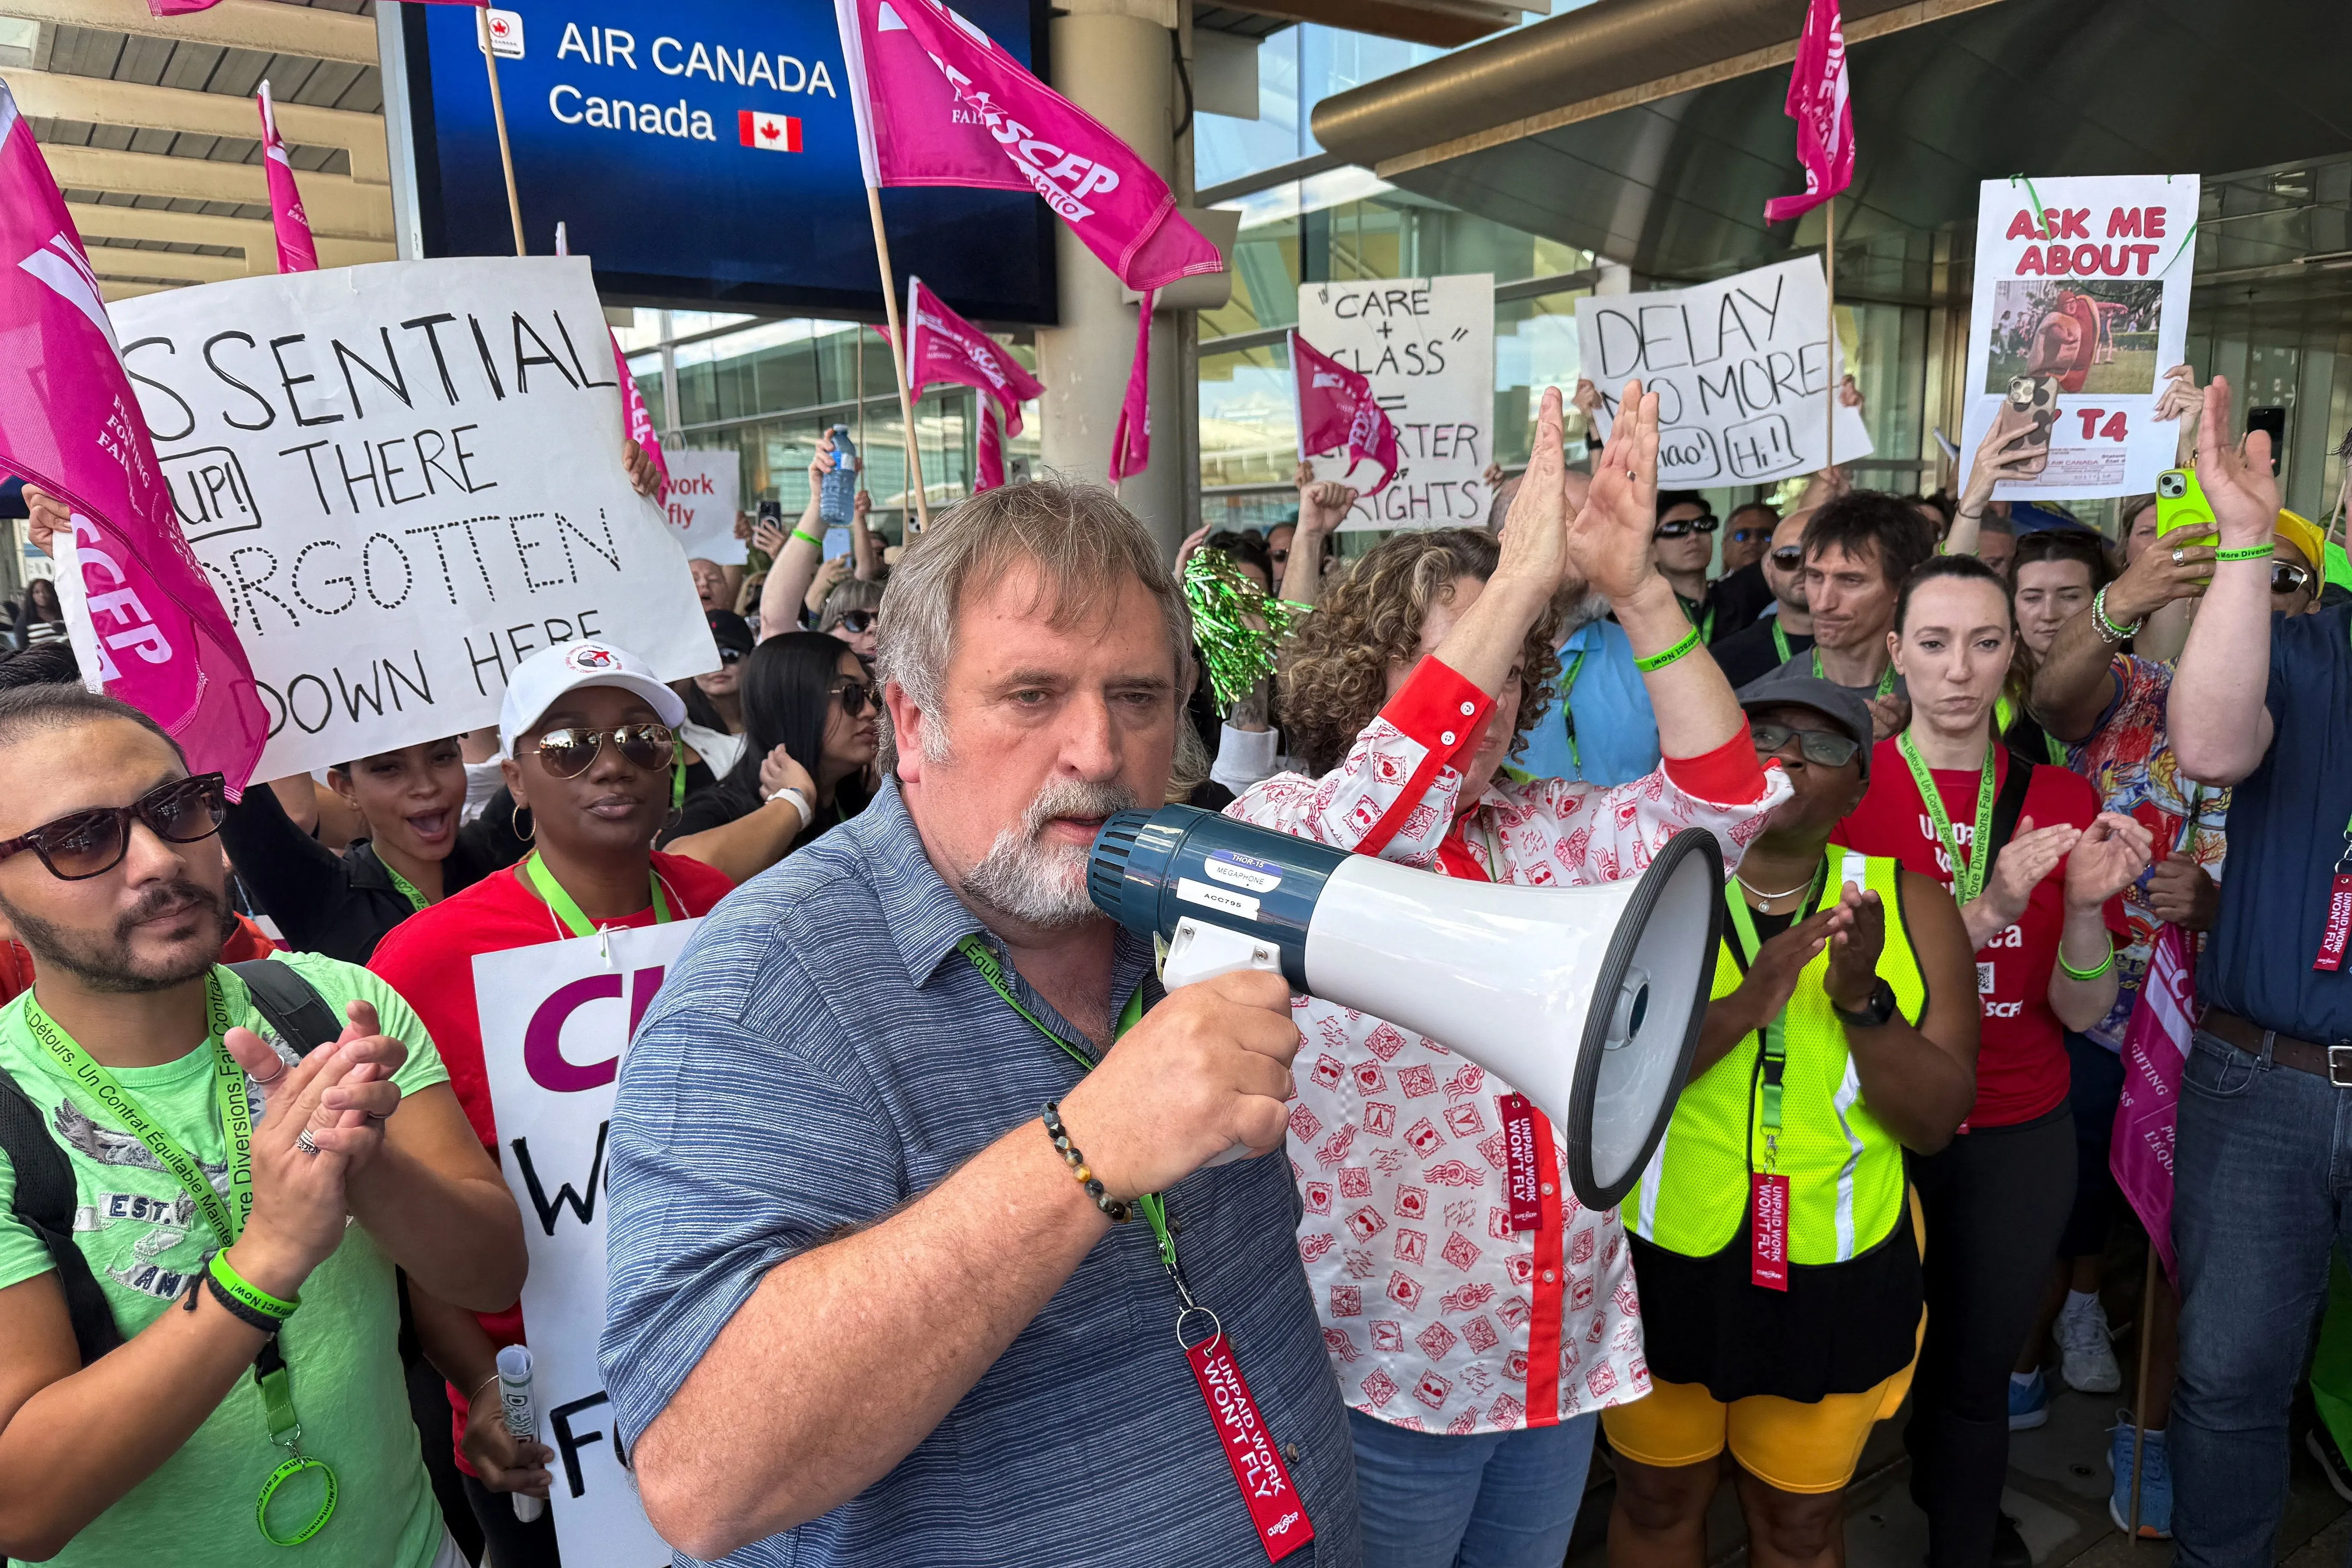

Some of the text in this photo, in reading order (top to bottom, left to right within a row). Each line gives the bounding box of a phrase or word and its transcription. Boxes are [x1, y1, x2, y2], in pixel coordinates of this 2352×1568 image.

[557, 22, 837, 98] AIR CANADA
[550, 85, 716, 142] Canada
[992, 119, 1119, 198] SCFP
[2006, 206, 2167, 241] ASK ME
[2015, 244, 2160, 276] ABOUT
[1596, 275, 1783, 379] DELAY
[121, 310, 617, 441] SSENTIAL
[1698, 341, 1839, 419] MORE
[2077, 408, 2129, 442] T4
[279, 425, 497, 515] THERE
[1658, 427, 1783, 472] iao! Hi!
[667, 502, 695, 530] fly
[202, 508, 621, 636] ORGOTTEN
[1651, 652, 1675, 668] Now!
[229, 650, 434, 747] DOWN
[1217, 867, 1265, 886] MEGAPHONE
[1232, 854, 1265, 868] THOR-15
[1204, 893, 1242, 908] ACC795
[2328, 892, 2343, 930] WON'T
[2332, 892, 2352, 953] UNPAID WORK
[2323, 932, 2336, 951] FLY
[2131, 1038, 2169, 1096] GHTING
[29, 1013, 75, 1067] Détours.
[77, 1063, 100, 1087] Un
[99, 1085, 150, 1133] Contrat
[145, 1130, 203, 1194] Équitable
[199, 1193, 234, 1247] Mainte
[1520, 1118, 1534, 1164] UNPAID
[2144, 1131, 2174, 1177] L'ÉQU
[509, 1119, 609, 1237] W
[1508, 1119, 1526, 1201] WON'T FLY
[1525, 1165, 1536, 1202] WORK
[109, 1195, 171, 1225] EST.
[1758, 1184, 1772, 1232] WON'T
[1771, 1186, 1783, 1263] UNPAID WORK
[1758, 1232, 1771, 1260] FLY
[230, 1283, 261, 1307] Now!
[1203, 1359, 1273, 1499] WON'T FLY
[1217, 1355, 1286, 1497] UNPAID WORK
